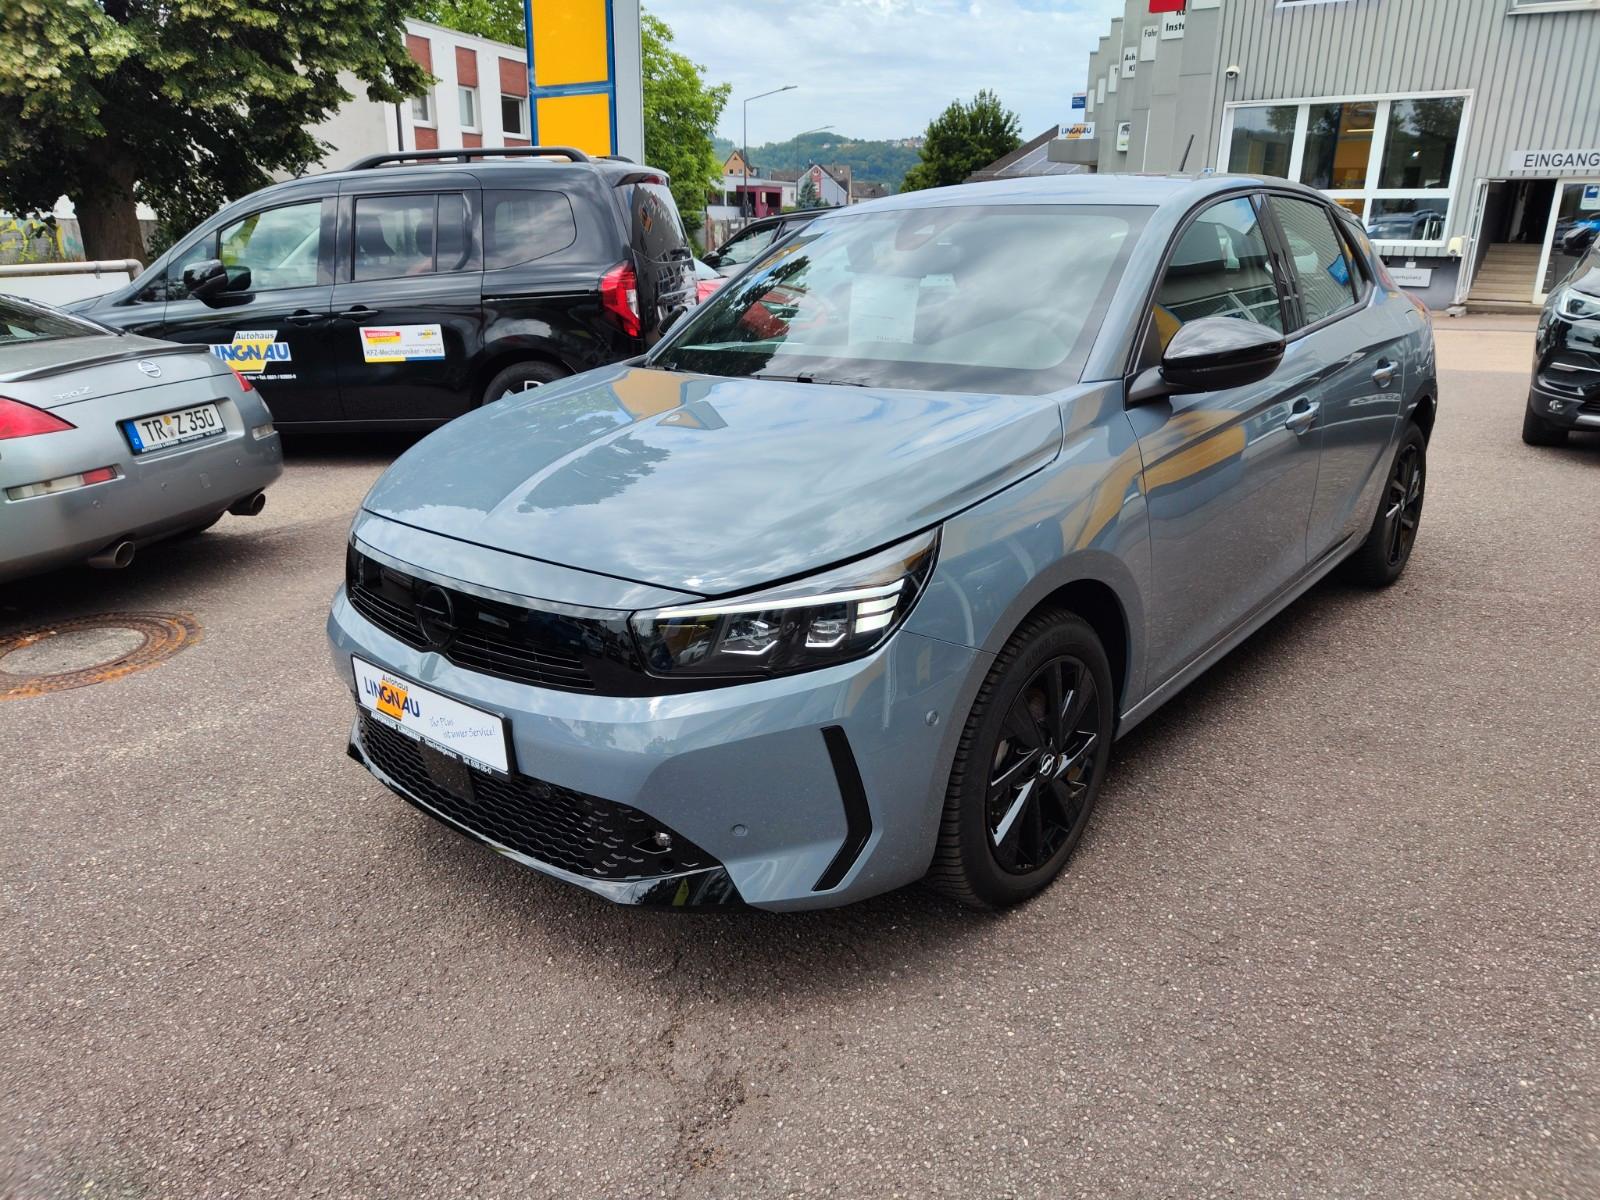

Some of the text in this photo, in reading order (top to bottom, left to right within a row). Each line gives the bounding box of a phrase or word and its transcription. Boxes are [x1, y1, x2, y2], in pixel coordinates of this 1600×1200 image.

[1524, 153, 1600, 168] EINGANG
[235, 332, 275, 340] Autohaus
[213, 343, 289, 361] INGNAU
[142, 420, 168, 442] TR
[172, 415, 187, 435] Z
[185, 408, 215, 431] 350
[382, 674, 408, 692] Autohaus
[364, 675, 420, 718] LINGNAU
